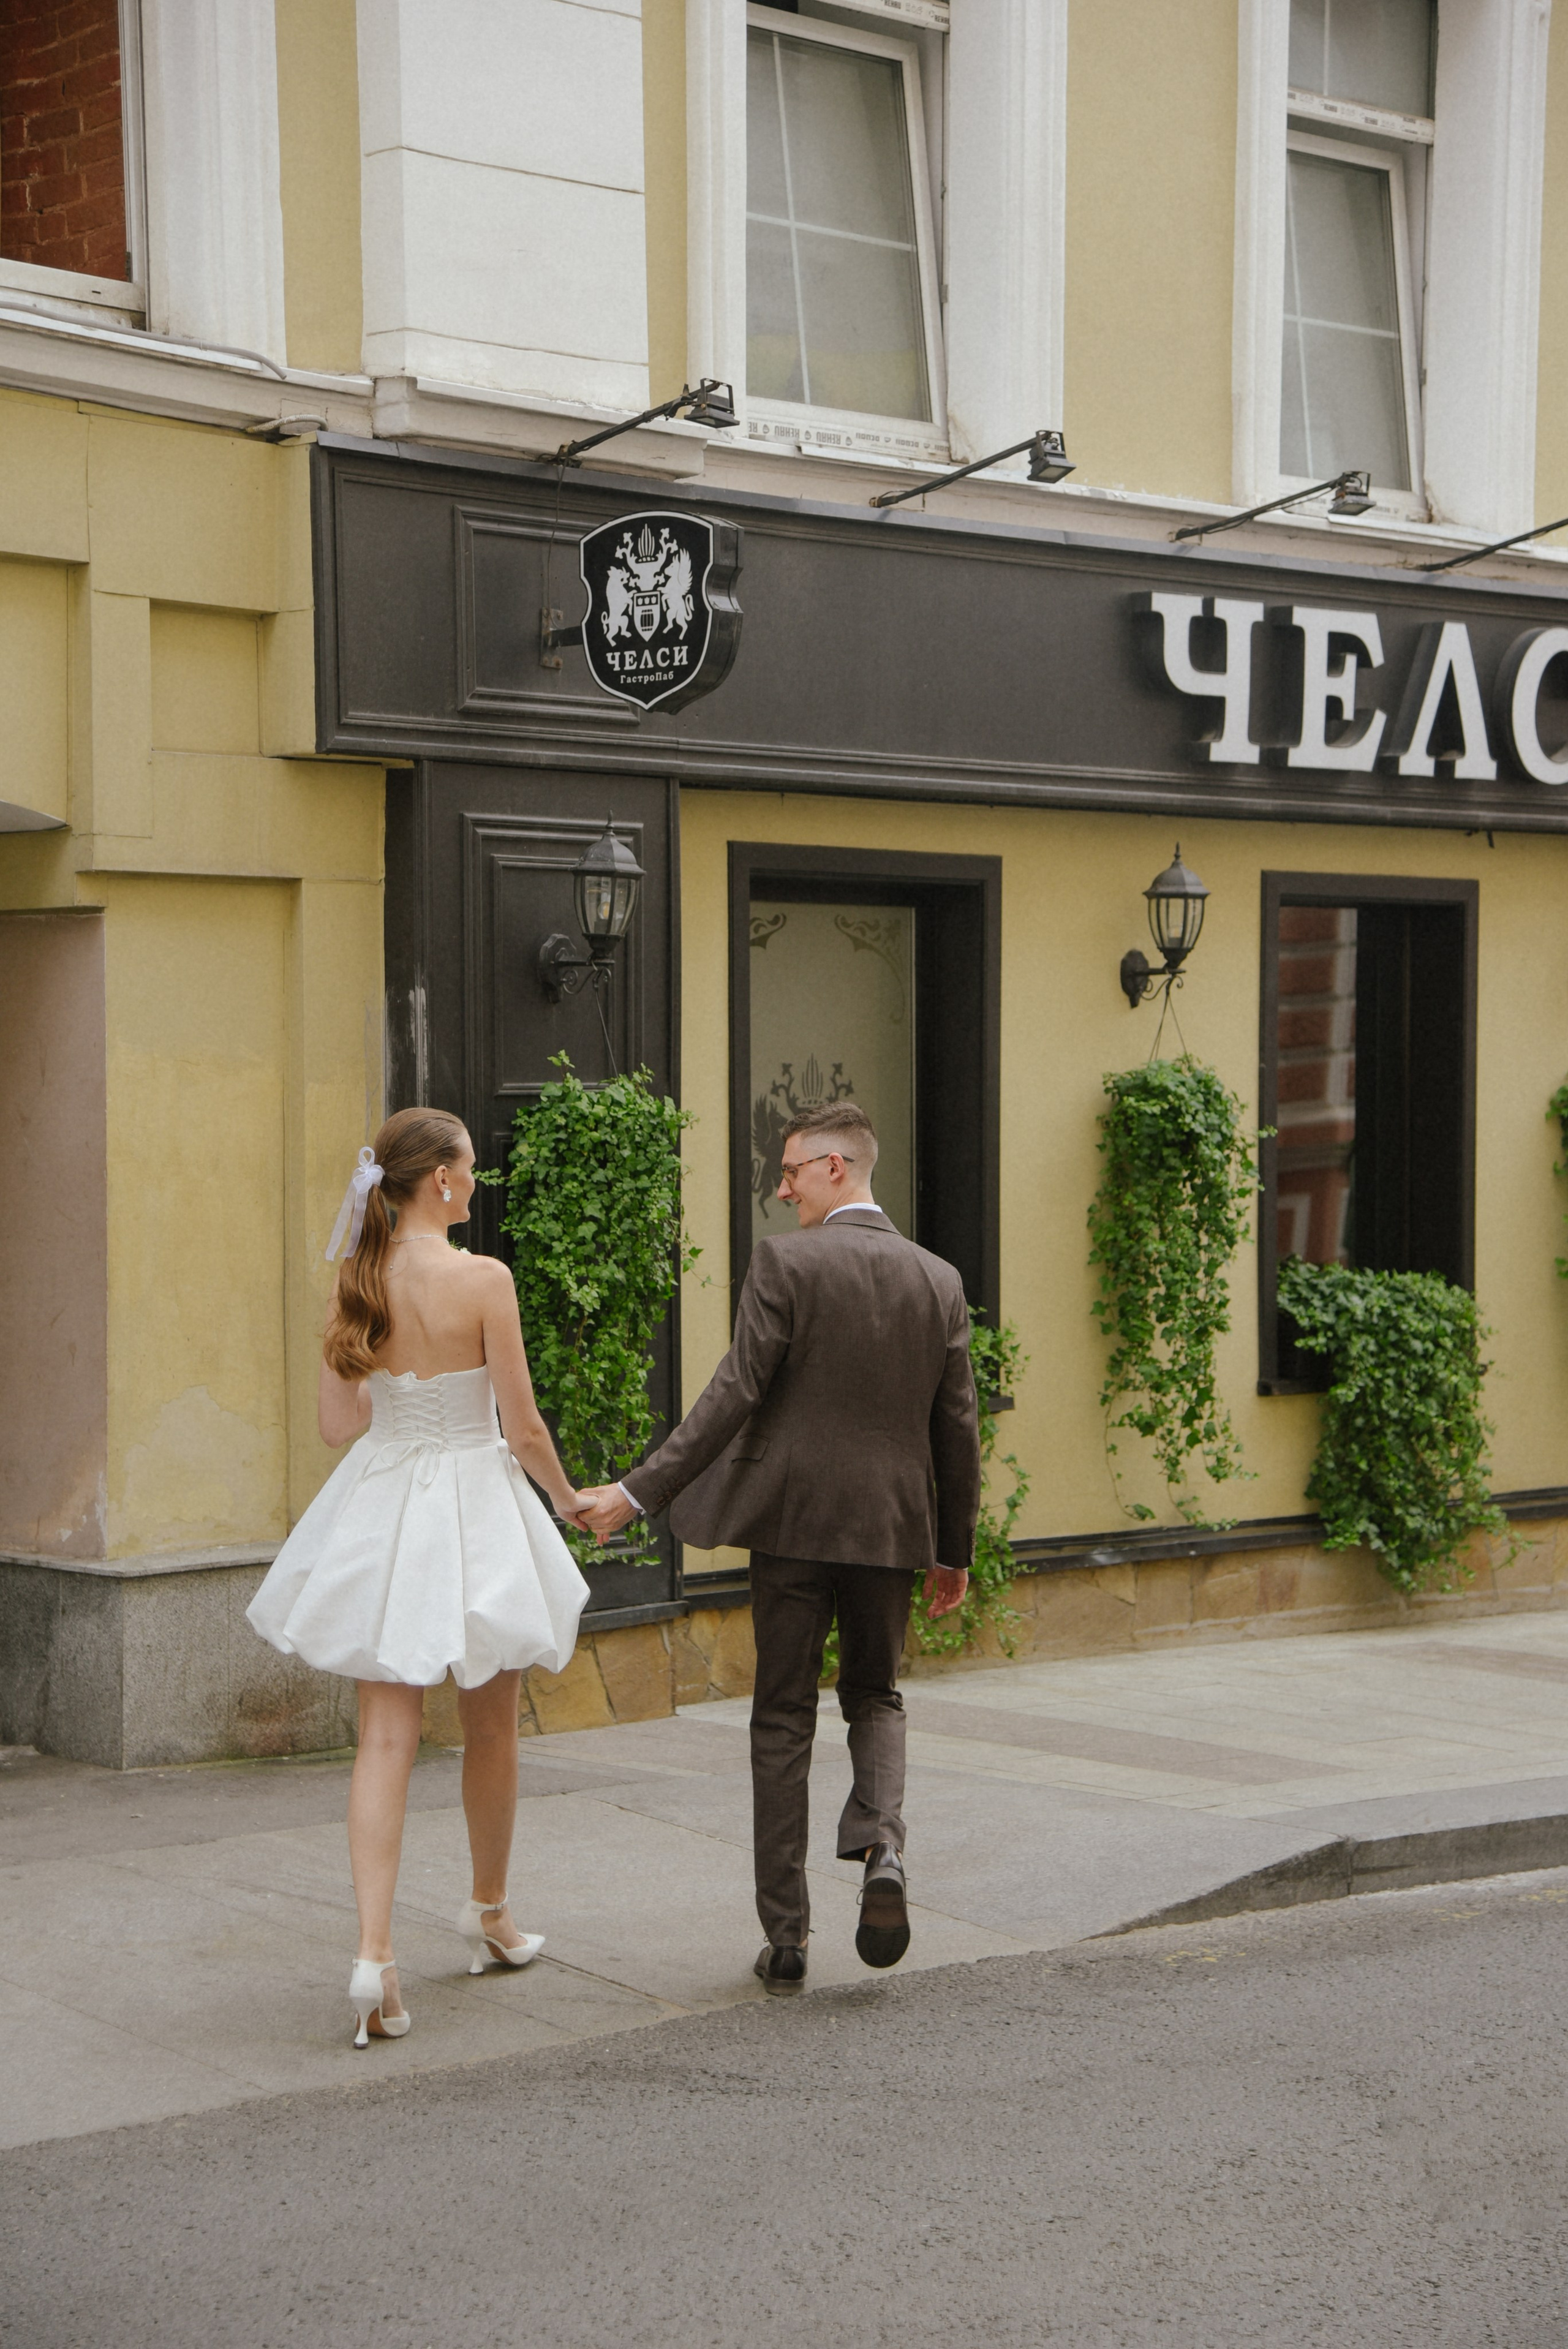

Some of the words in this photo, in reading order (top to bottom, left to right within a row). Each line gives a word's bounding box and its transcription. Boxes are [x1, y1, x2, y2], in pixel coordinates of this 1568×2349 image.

[816, 431, 841, 445] REHAU
[606, 646, 688, 671] ЧЕЛСИ
[620, 671, 674, 685] ГастроПаб
